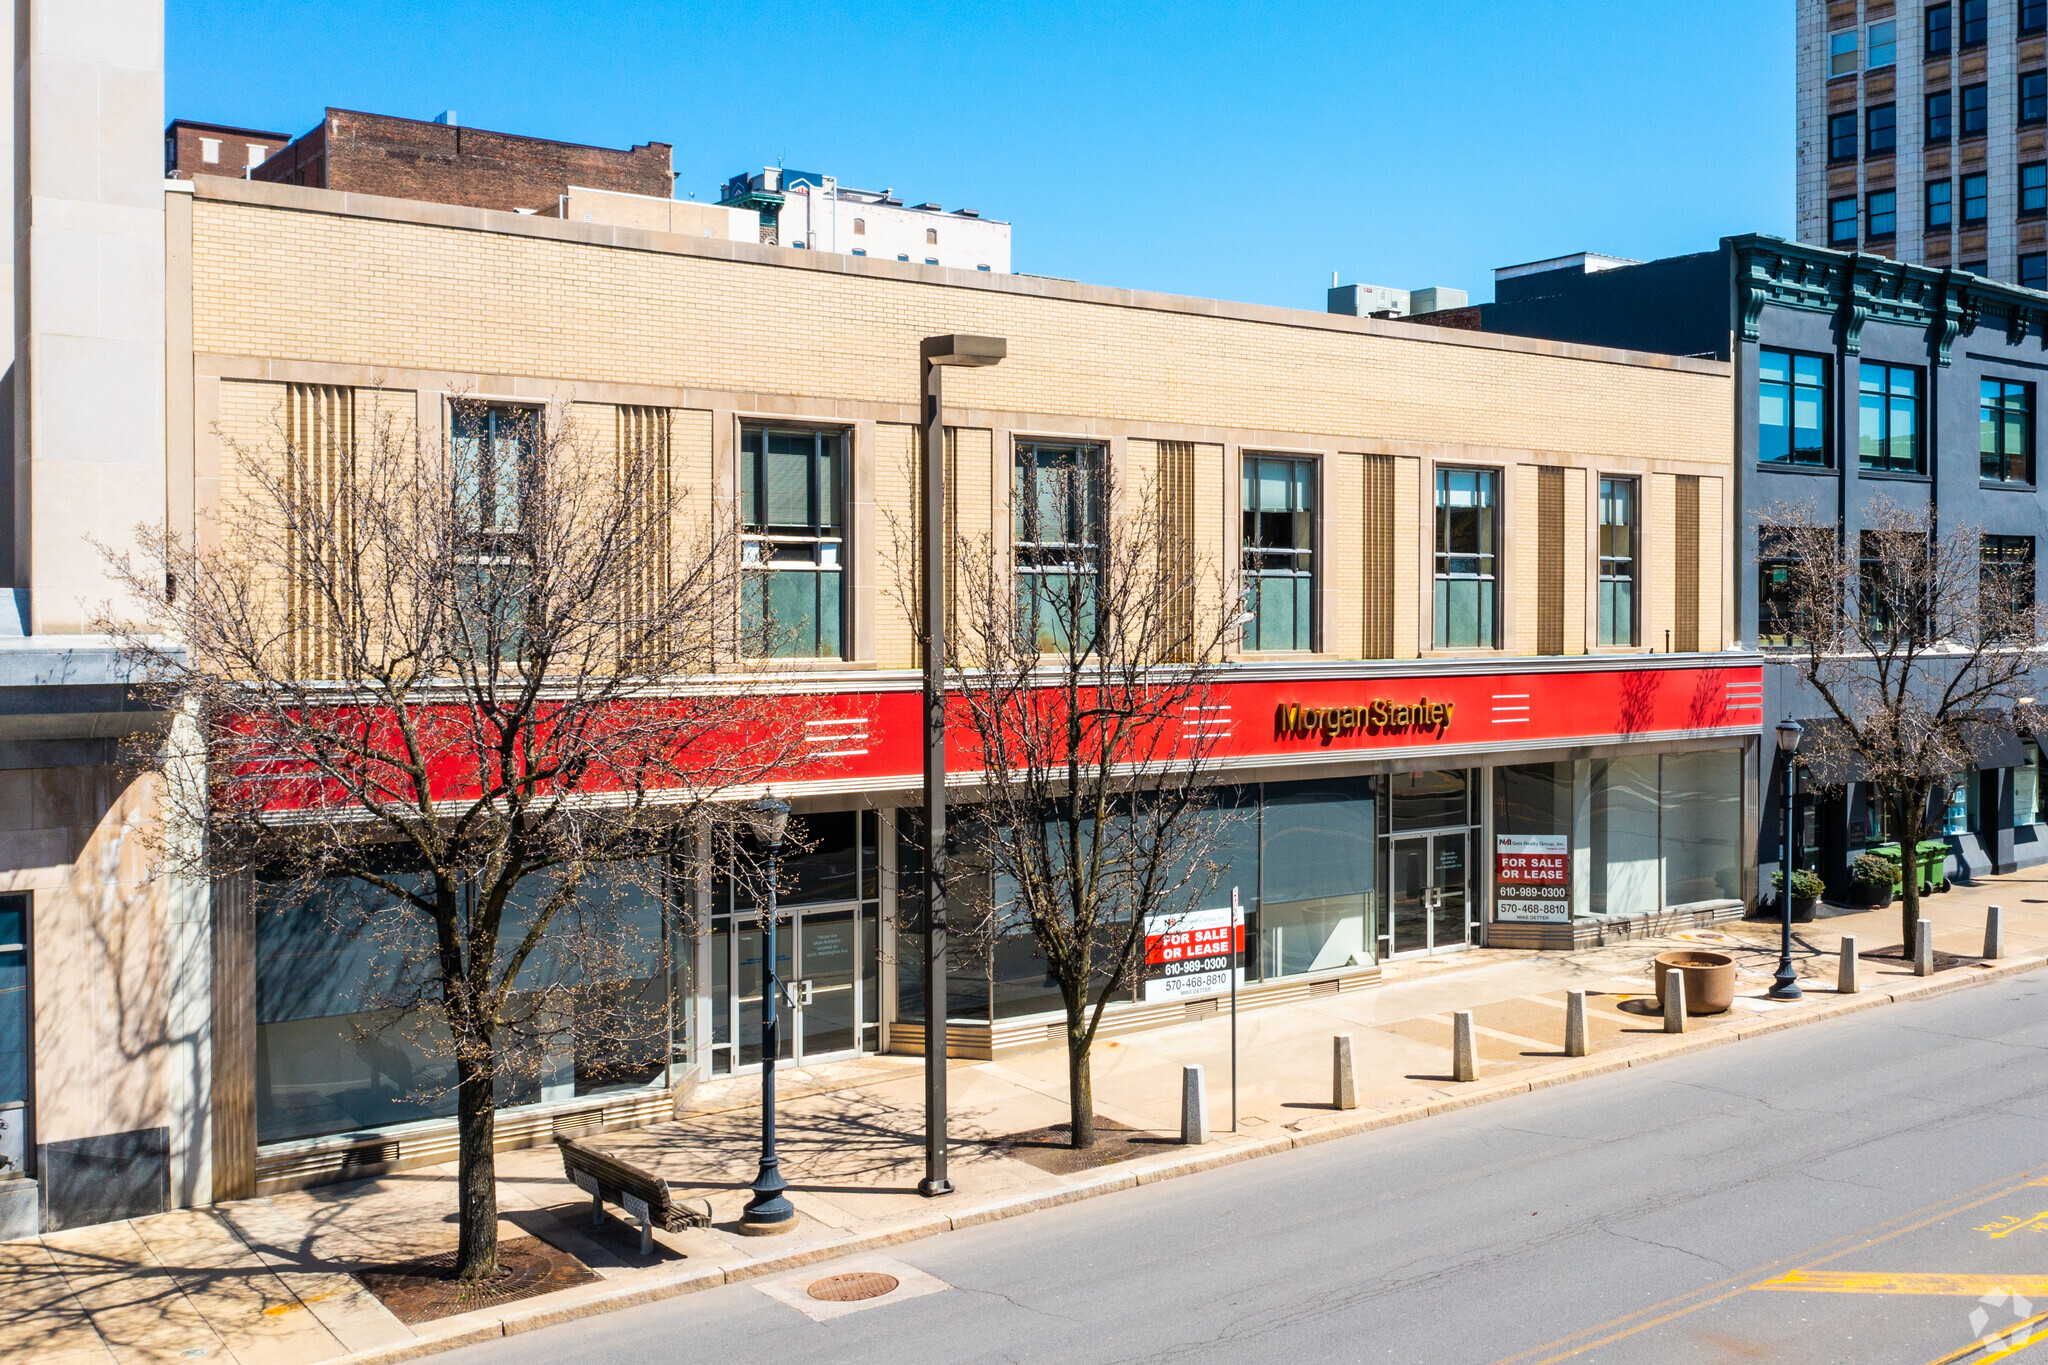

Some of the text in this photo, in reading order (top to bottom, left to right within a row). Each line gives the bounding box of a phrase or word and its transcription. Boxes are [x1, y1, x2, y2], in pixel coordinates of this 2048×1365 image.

[1500, 838, 1511, 846] NAI
[1502, 858, 1562, 868] FOR SALE
[1502, 870, 1563, 879] OR LEASE
[1500, 887, 1565, 897] 610-989-0300
[1501, 904, 1565, 914] 570-468-8810
[1163, 928, 1228, 946] FOR SALE
[1163, 942, 1229, 960] OR LEASE
[1165, 957, 1227, 976] 610-989-0300
[1165, 973, 1226, 992] 570-468-8810
